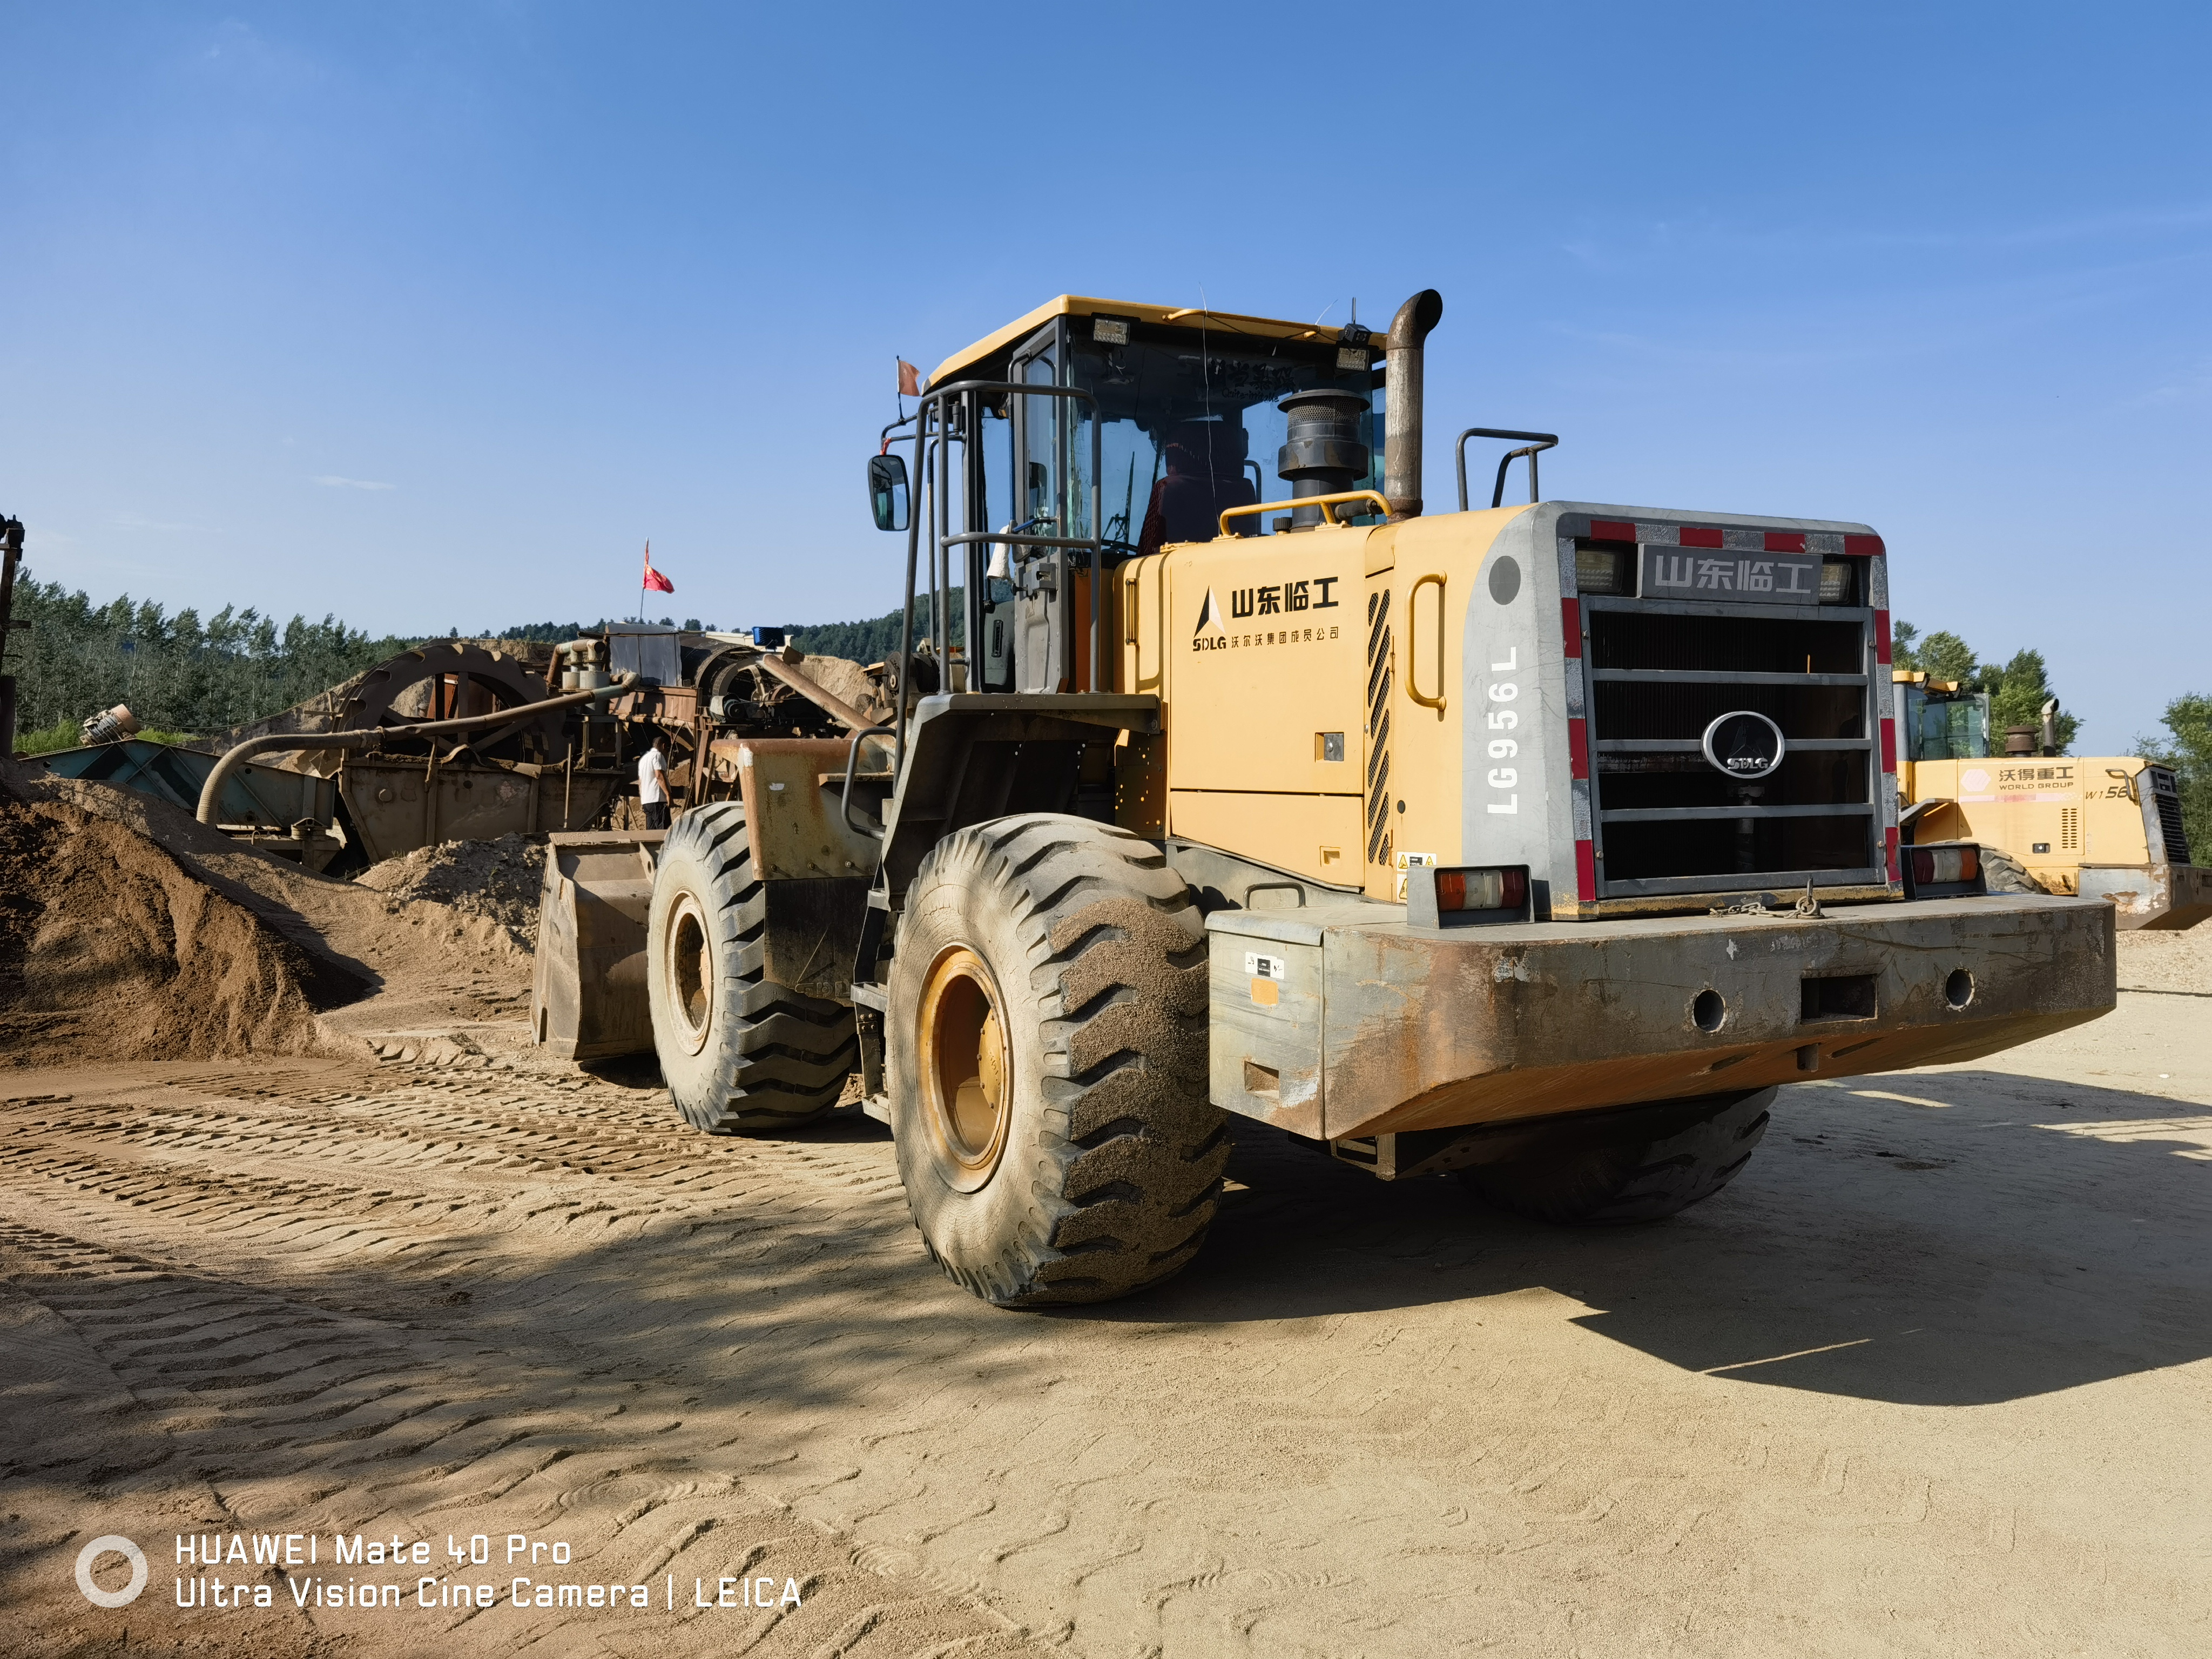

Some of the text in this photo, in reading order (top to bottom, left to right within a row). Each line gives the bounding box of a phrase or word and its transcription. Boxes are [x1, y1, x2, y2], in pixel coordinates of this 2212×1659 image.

[1655, 555, 1813, 594] 山东临工
[1232, 576, 1339, 618] 山东临工
[1192, 637, 1226, 652] SDLG
[1231, 626, 1339, 648] 沃尔沃集团成员公司
[1487, 646, 1518, 814] LG956L
[1727, 757, 1769, 770] SDLG
[1999, 766, 2074, 782] 沃得重工
